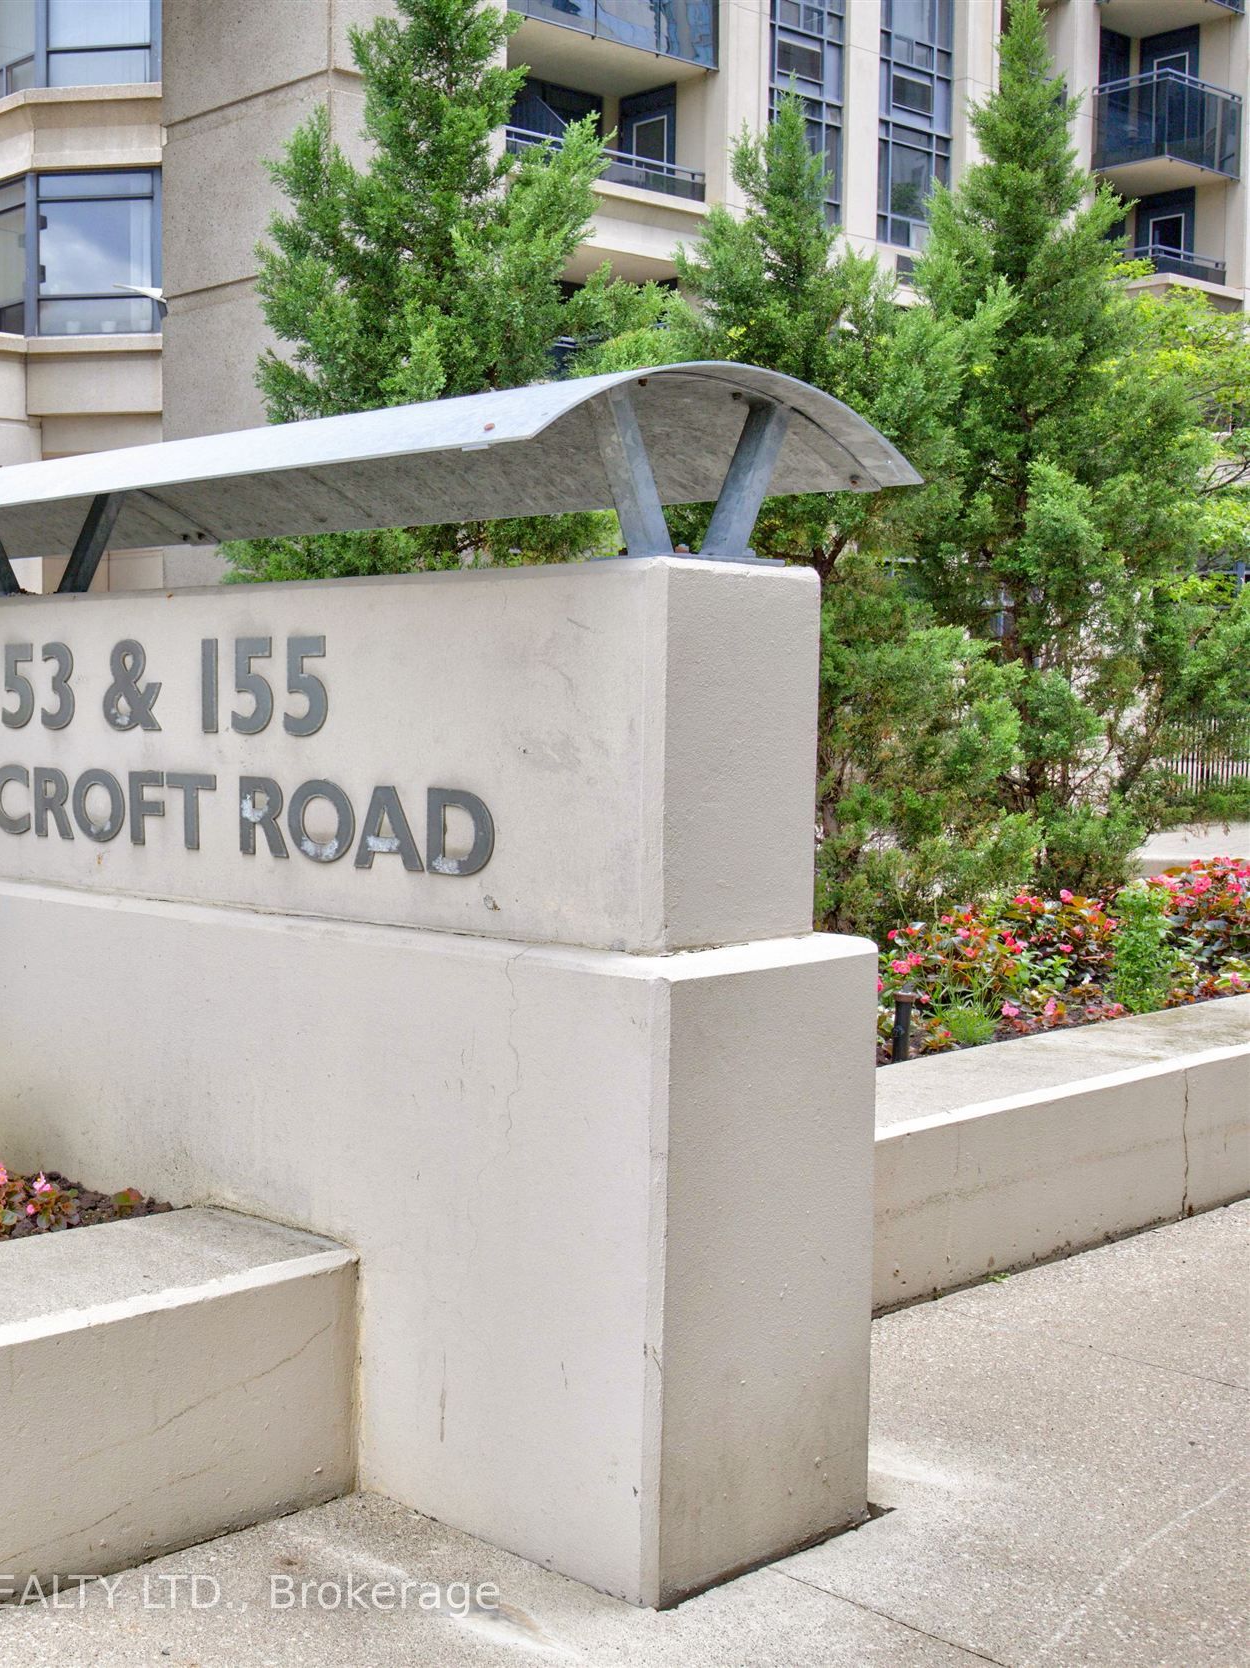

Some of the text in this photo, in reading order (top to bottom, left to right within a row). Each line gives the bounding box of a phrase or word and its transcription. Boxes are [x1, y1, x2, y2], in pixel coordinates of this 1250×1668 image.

[102, 638, 163, 732] &
[200, 635, 329, 738] 155
[238, 774, 496, 877] ROAD
